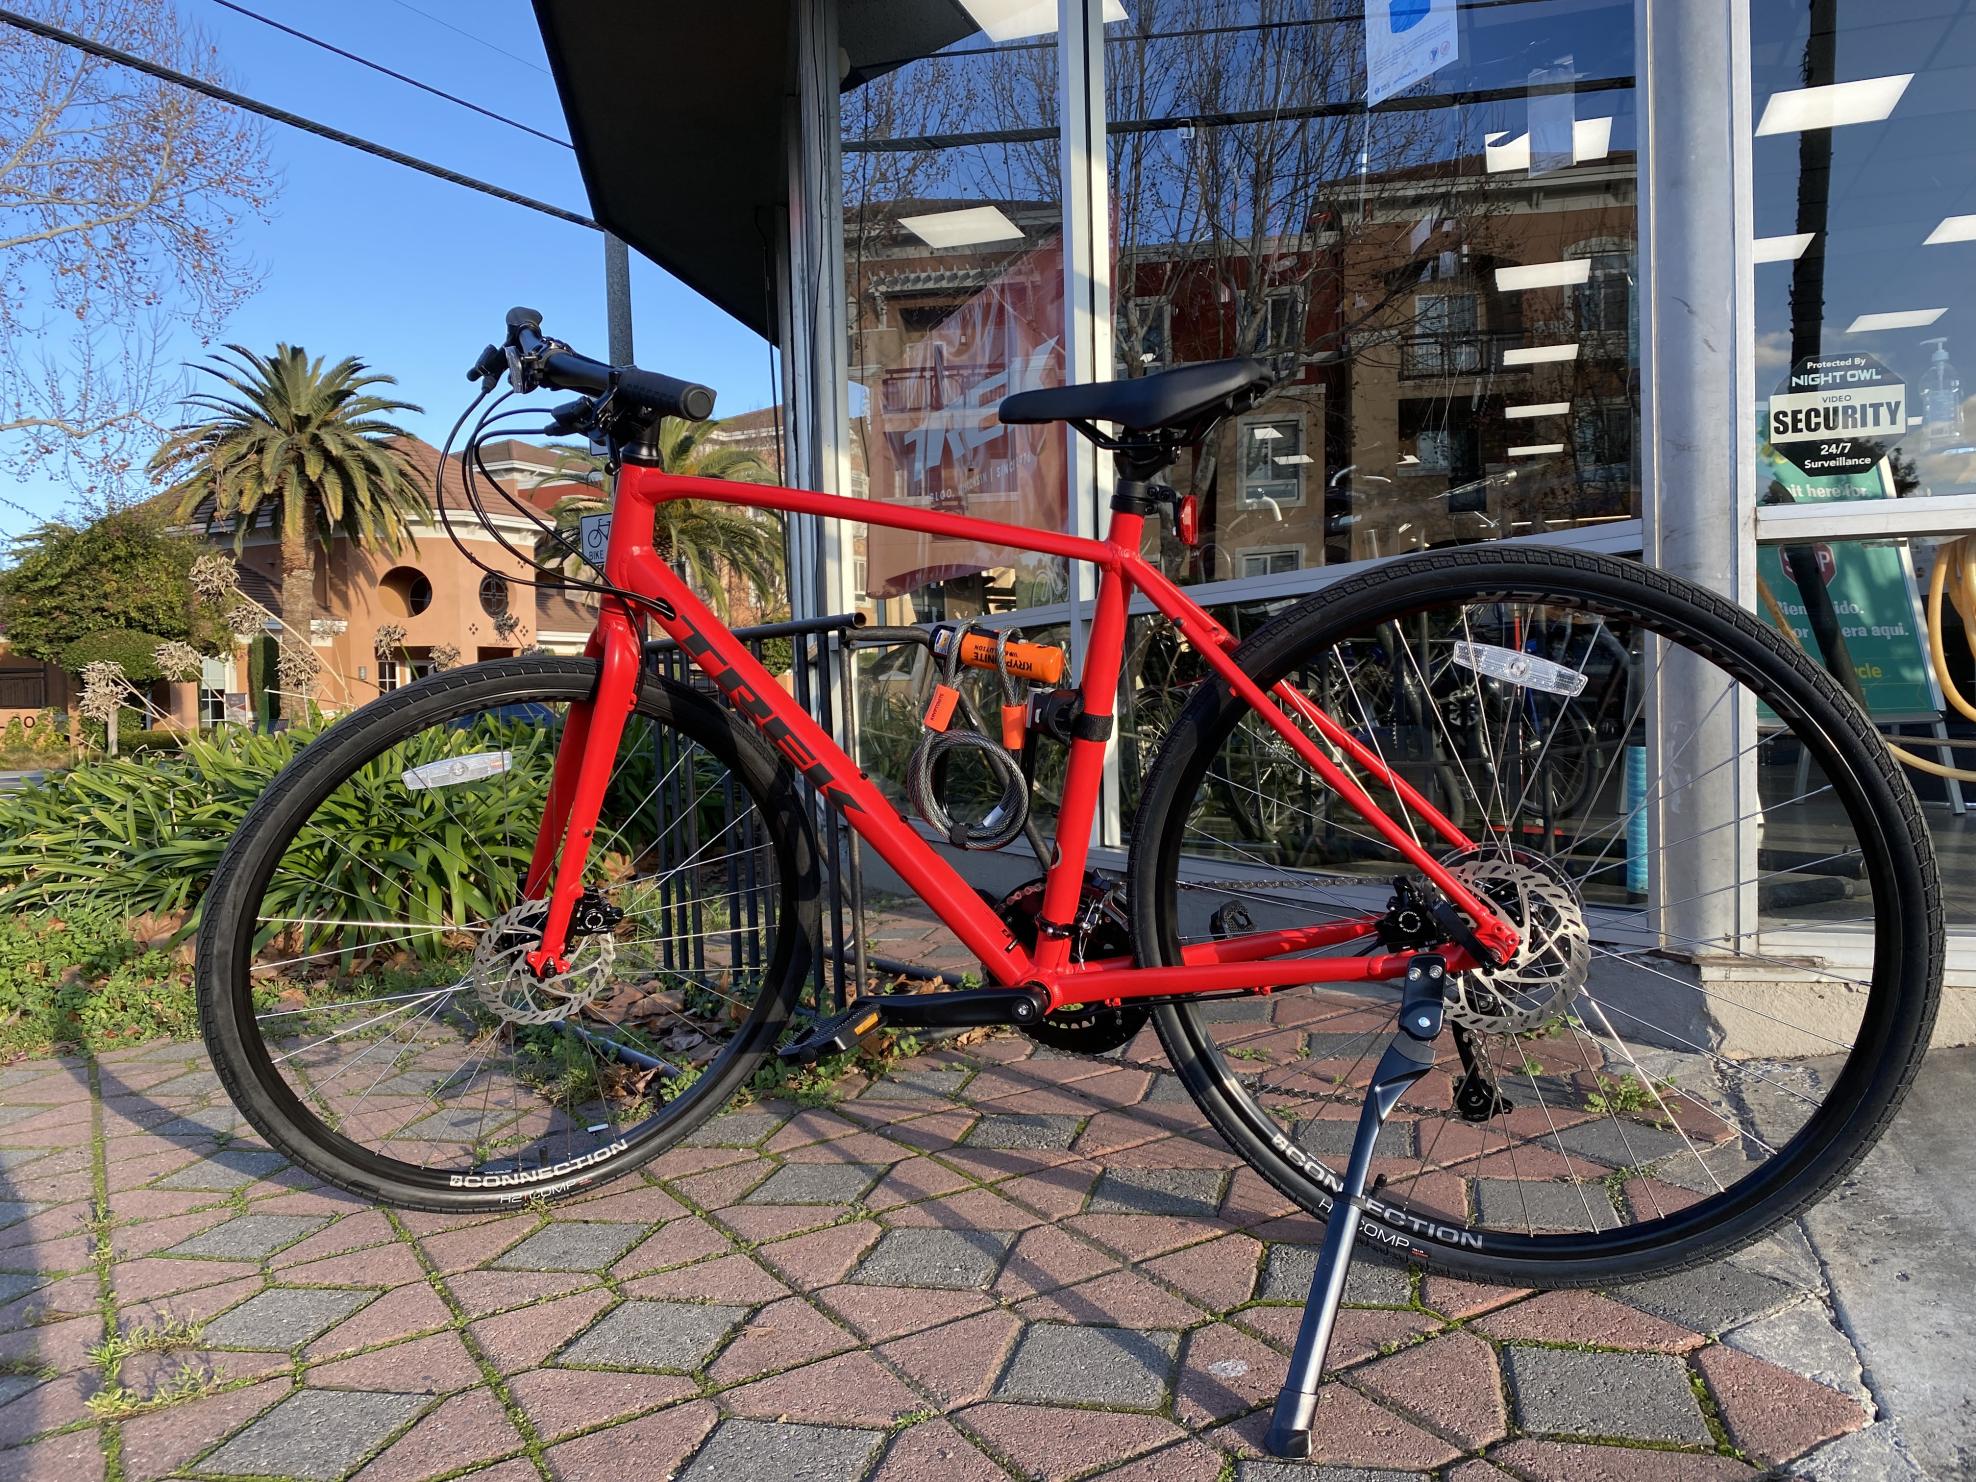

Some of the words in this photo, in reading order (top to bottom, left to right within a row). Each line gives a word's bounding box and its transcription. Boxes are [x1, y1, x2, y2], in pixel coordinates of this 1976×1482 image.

[1807, 357, 1852, 369] Protected
[1854, 357, 1866, 366] By
[1791, 371, 1845, 387] NIGHT
[1847, 368, 1882, 382] OWL
[1822, 394, 1852, 403] VIDEO
[1773, 400, 1901, 435] SECURITY
[1820, 443, 1851, 455] 24/7
[1804, 456, 1872, 469] Surveillance
[1806, 484, 1840, 497] here
[589, 550, 604, 560] BIKE
[973, 651, 1033, 672] KRYPNITE
[680, 613, 867, 815] TREK
[461, 1139, 629, 1188] CONNECTION
[1286, 1145, 1483, 1249] CONECTION
